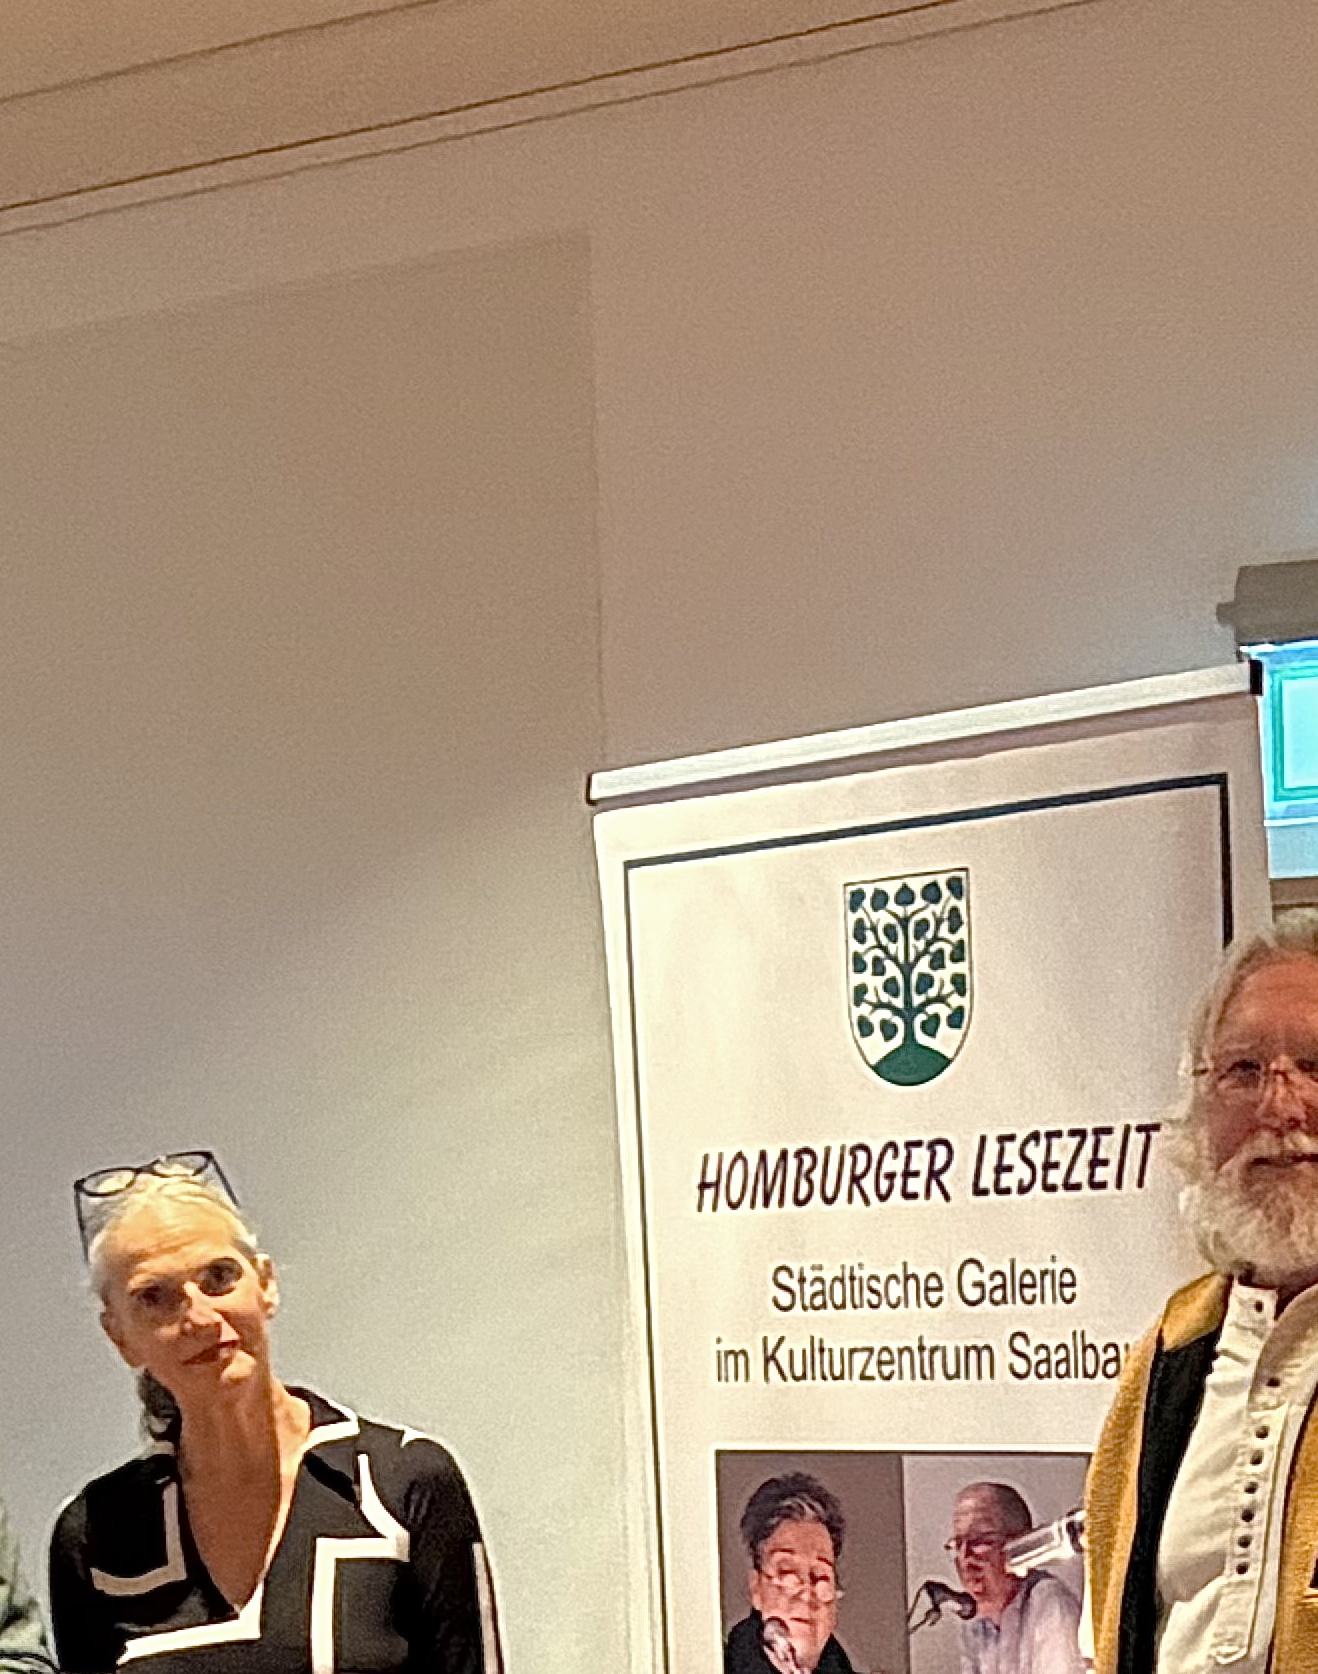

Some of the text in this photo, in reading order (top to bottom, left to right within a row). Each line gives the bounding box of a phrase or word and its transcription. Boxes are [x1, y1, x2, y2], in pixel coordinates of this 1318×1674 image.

[697, 1124, 1161, 1212] HOMBURGER LESEZEIT
[772, 1254, 1077, 1312] Städtische Galerie
[716, 1330, 1130, 1383] im Kulturzentrum Saalba
